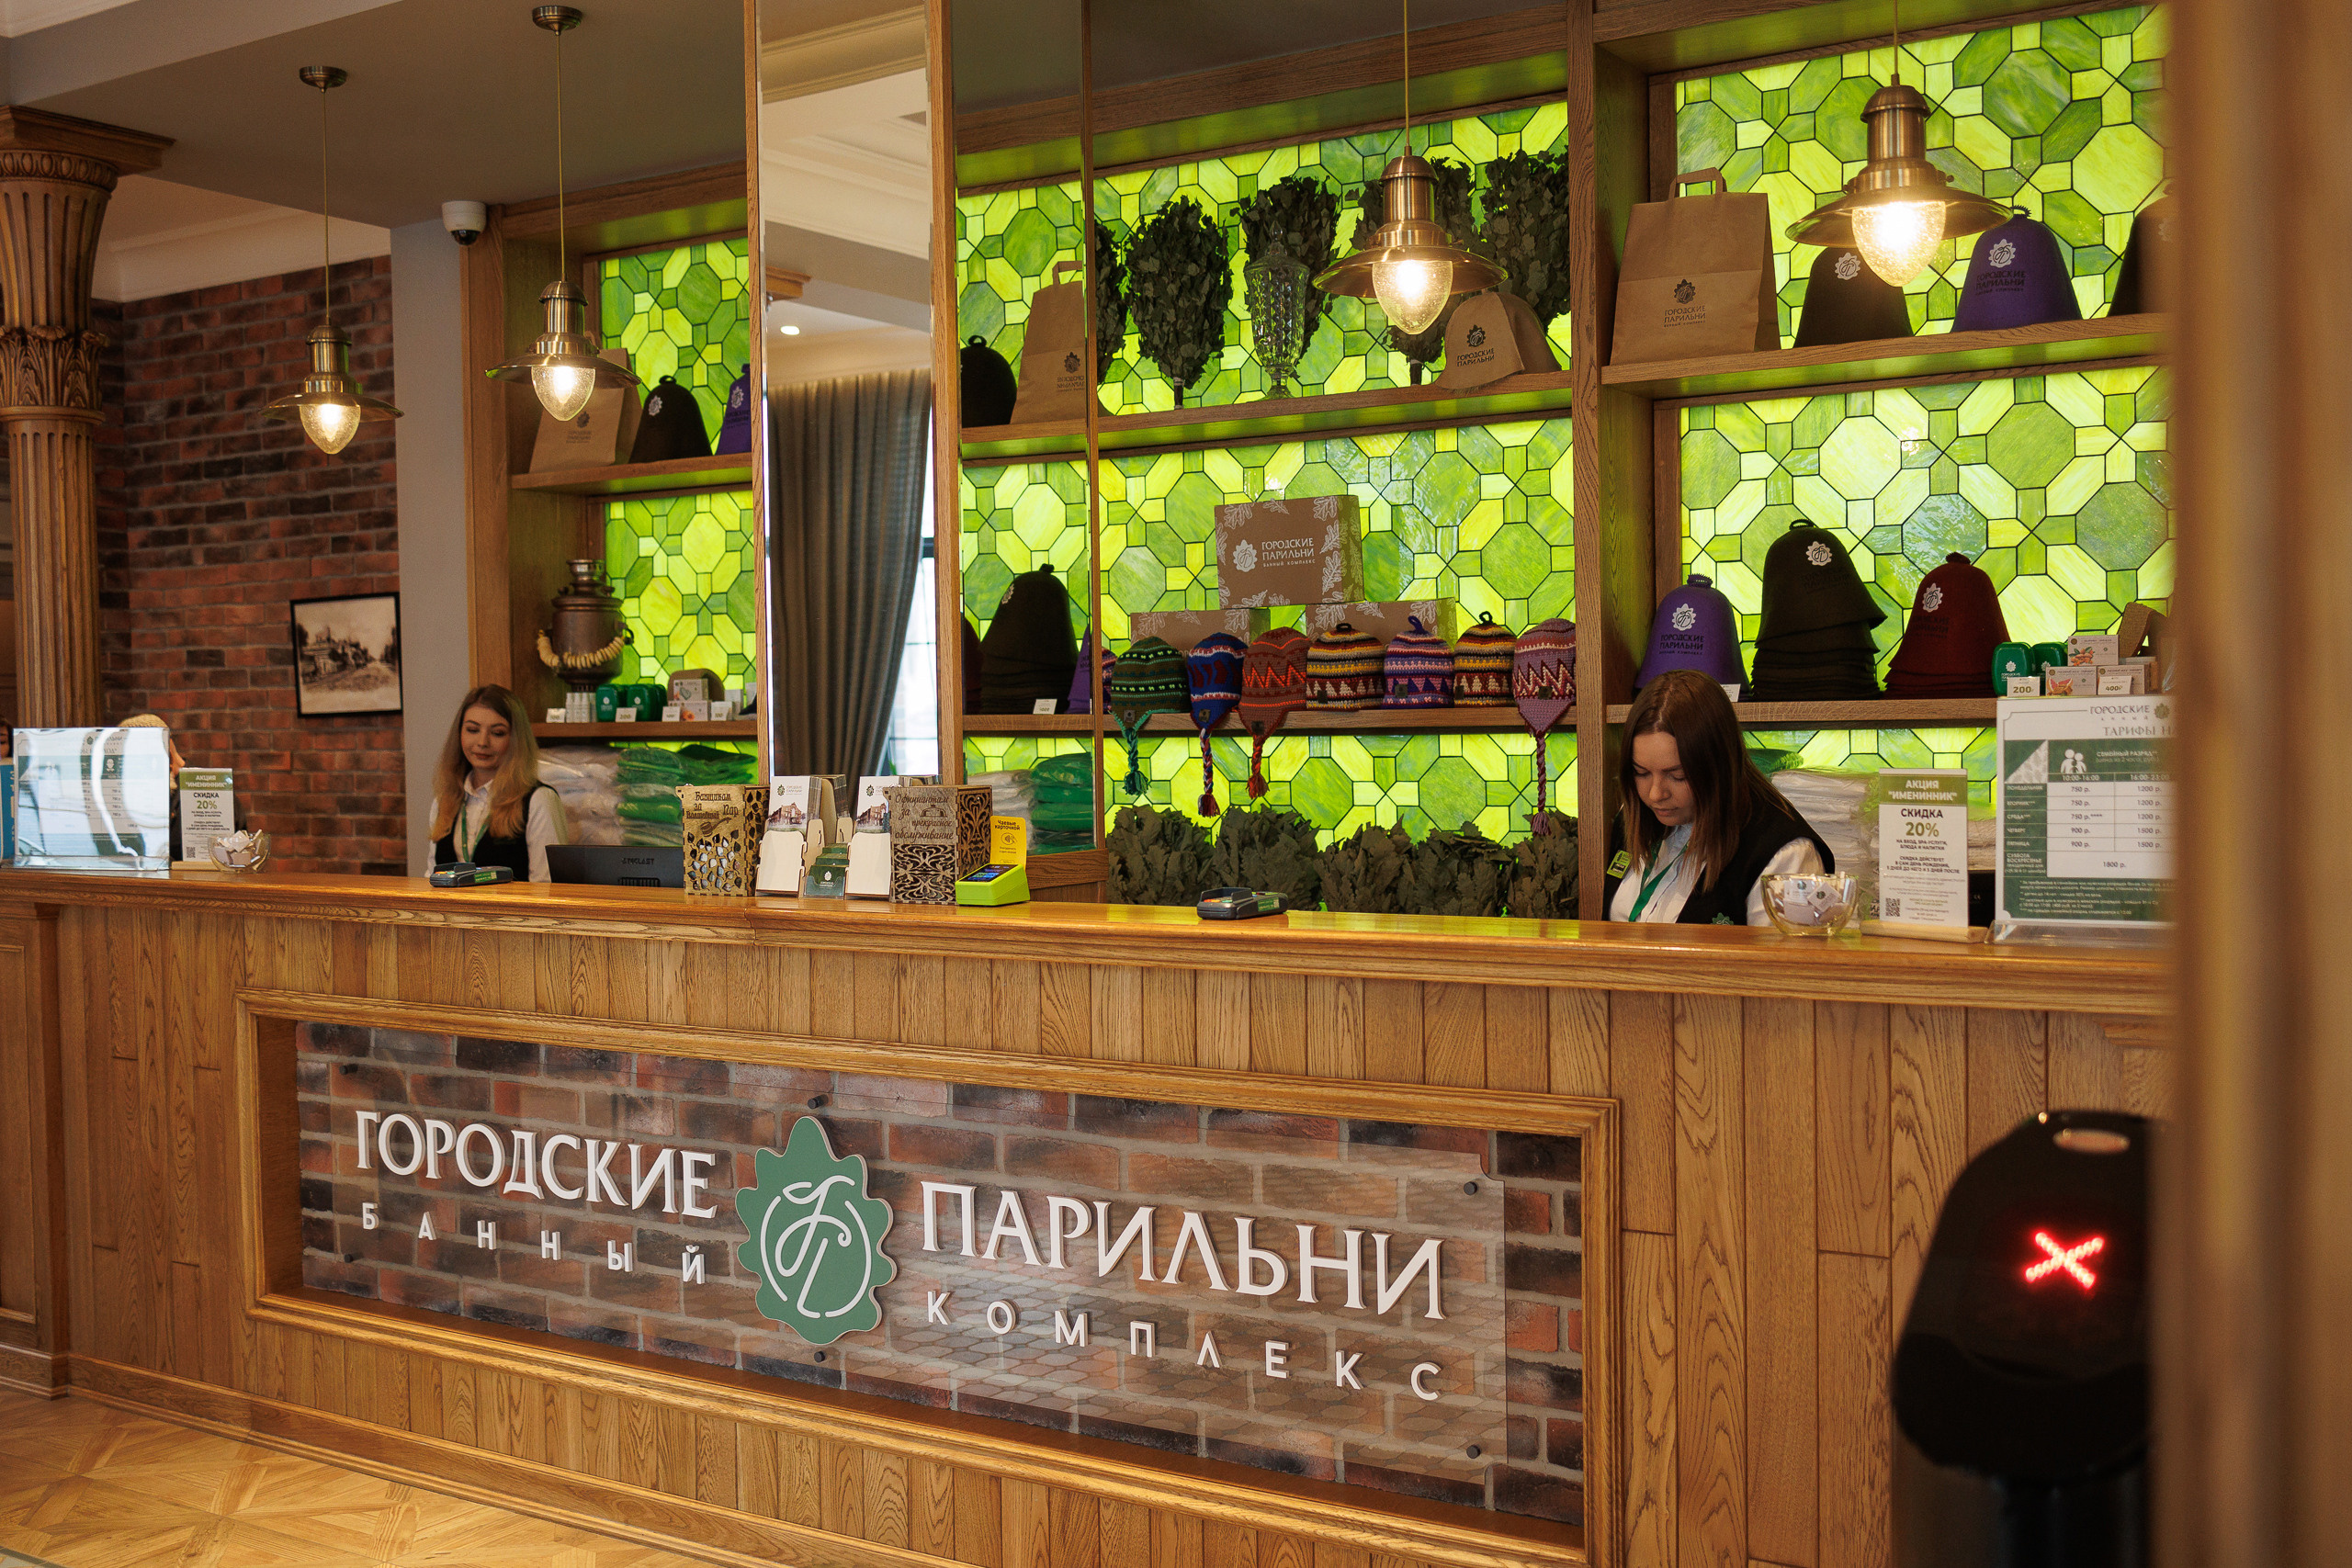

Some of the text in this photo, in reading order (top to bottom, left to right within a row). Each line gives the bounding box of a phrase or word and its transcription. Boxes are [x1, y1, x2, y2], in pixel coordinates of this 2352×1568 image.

[1664, 306, 1706, 316] ГОРОДСКИЕ
[1664, 312, 1706, 322] ПАРИЛЬНИ
[1457, 347, 1494, 361] ГОРОДСКИЕ
[1457, 355, 1495, 367] ПАРИЛЬНИ
[1261, 537, 1315, 550] ГОРОДСКИЕ
[1262, 548, 1315, 561] ПАРИЛЬНИ
[1661, 634, 1705, 642] ГОРОДСКИЕ
[1659, 642, 1704, 650] ПАРИЛЬНИ
[2090, 705, 2150, 714] ГОРОДСКИЕ
[2103, 726, 2155, 736] ТАРИФЫ
[1905, 780, 1939, 790] АКЦИЯ
[895, 794, 949, 807] Официантам
[1888, 791, 1958, 801] "ИМЕНИННИК"
[197, 800, 218, 809] 20%
[723, 804, 739, 817] Пар
[898, 808, 910, 820] за
[1901, 808, 1943, 819] СКИДКА
[911, 820, 953, 829] прекрасное
[1905, 821, 1939, 837] 20%
[895, 827, 954, 843] обслуживание
[356, 1111, 1447, 1321] ГОРОДСКИЕ ПАРИЛЬНИ
[362, 1201, 1442, 1402] БАННЫЙ КОМПЛЕКС
